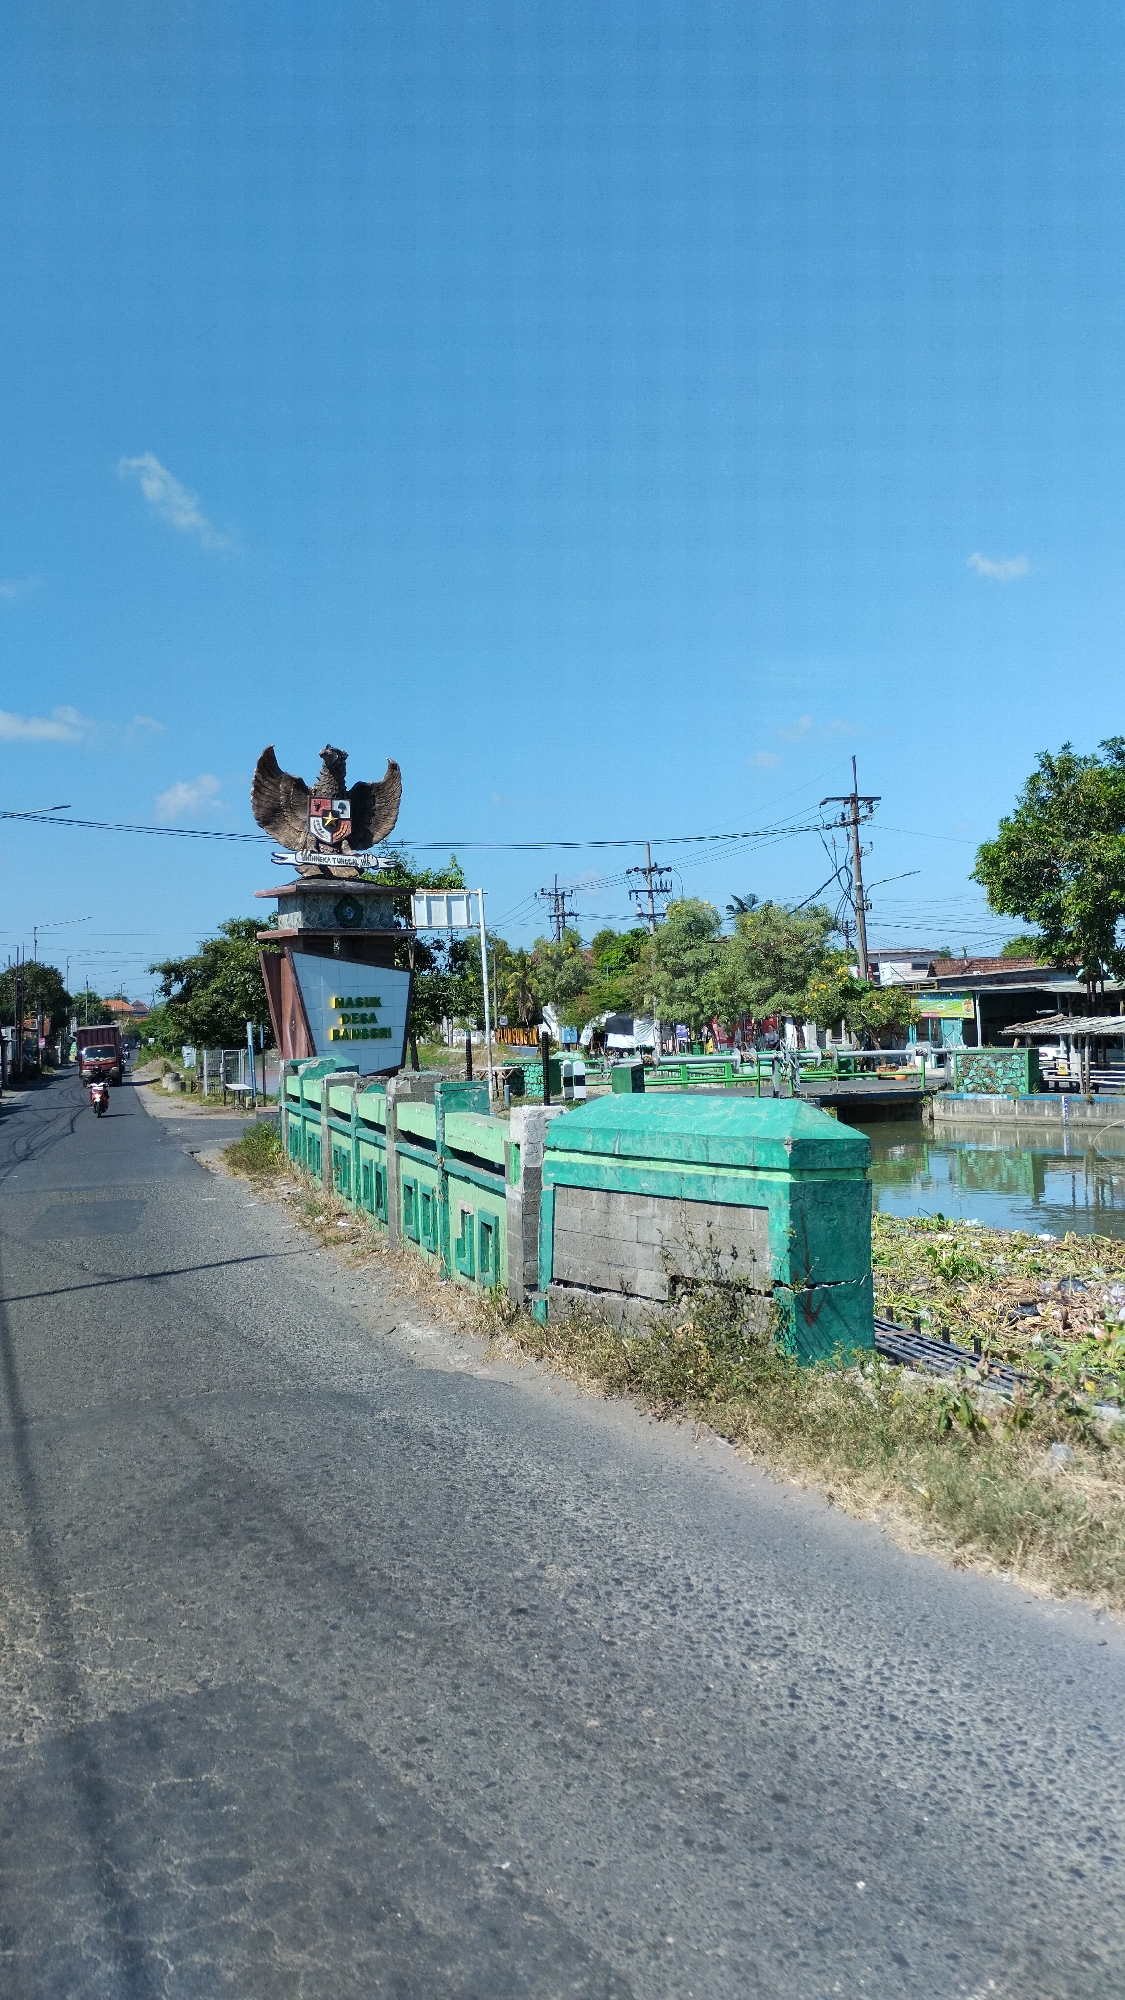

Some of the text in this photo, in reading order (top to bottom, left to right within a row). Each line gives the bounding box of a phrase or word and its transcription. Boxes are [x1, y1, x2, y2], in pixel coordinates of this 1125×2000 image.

[332, 996, 382, 1009] MASUK
[340, 1012, 378, 1025] DESA
[330, 1027, 392, 1040] BANGSRI
